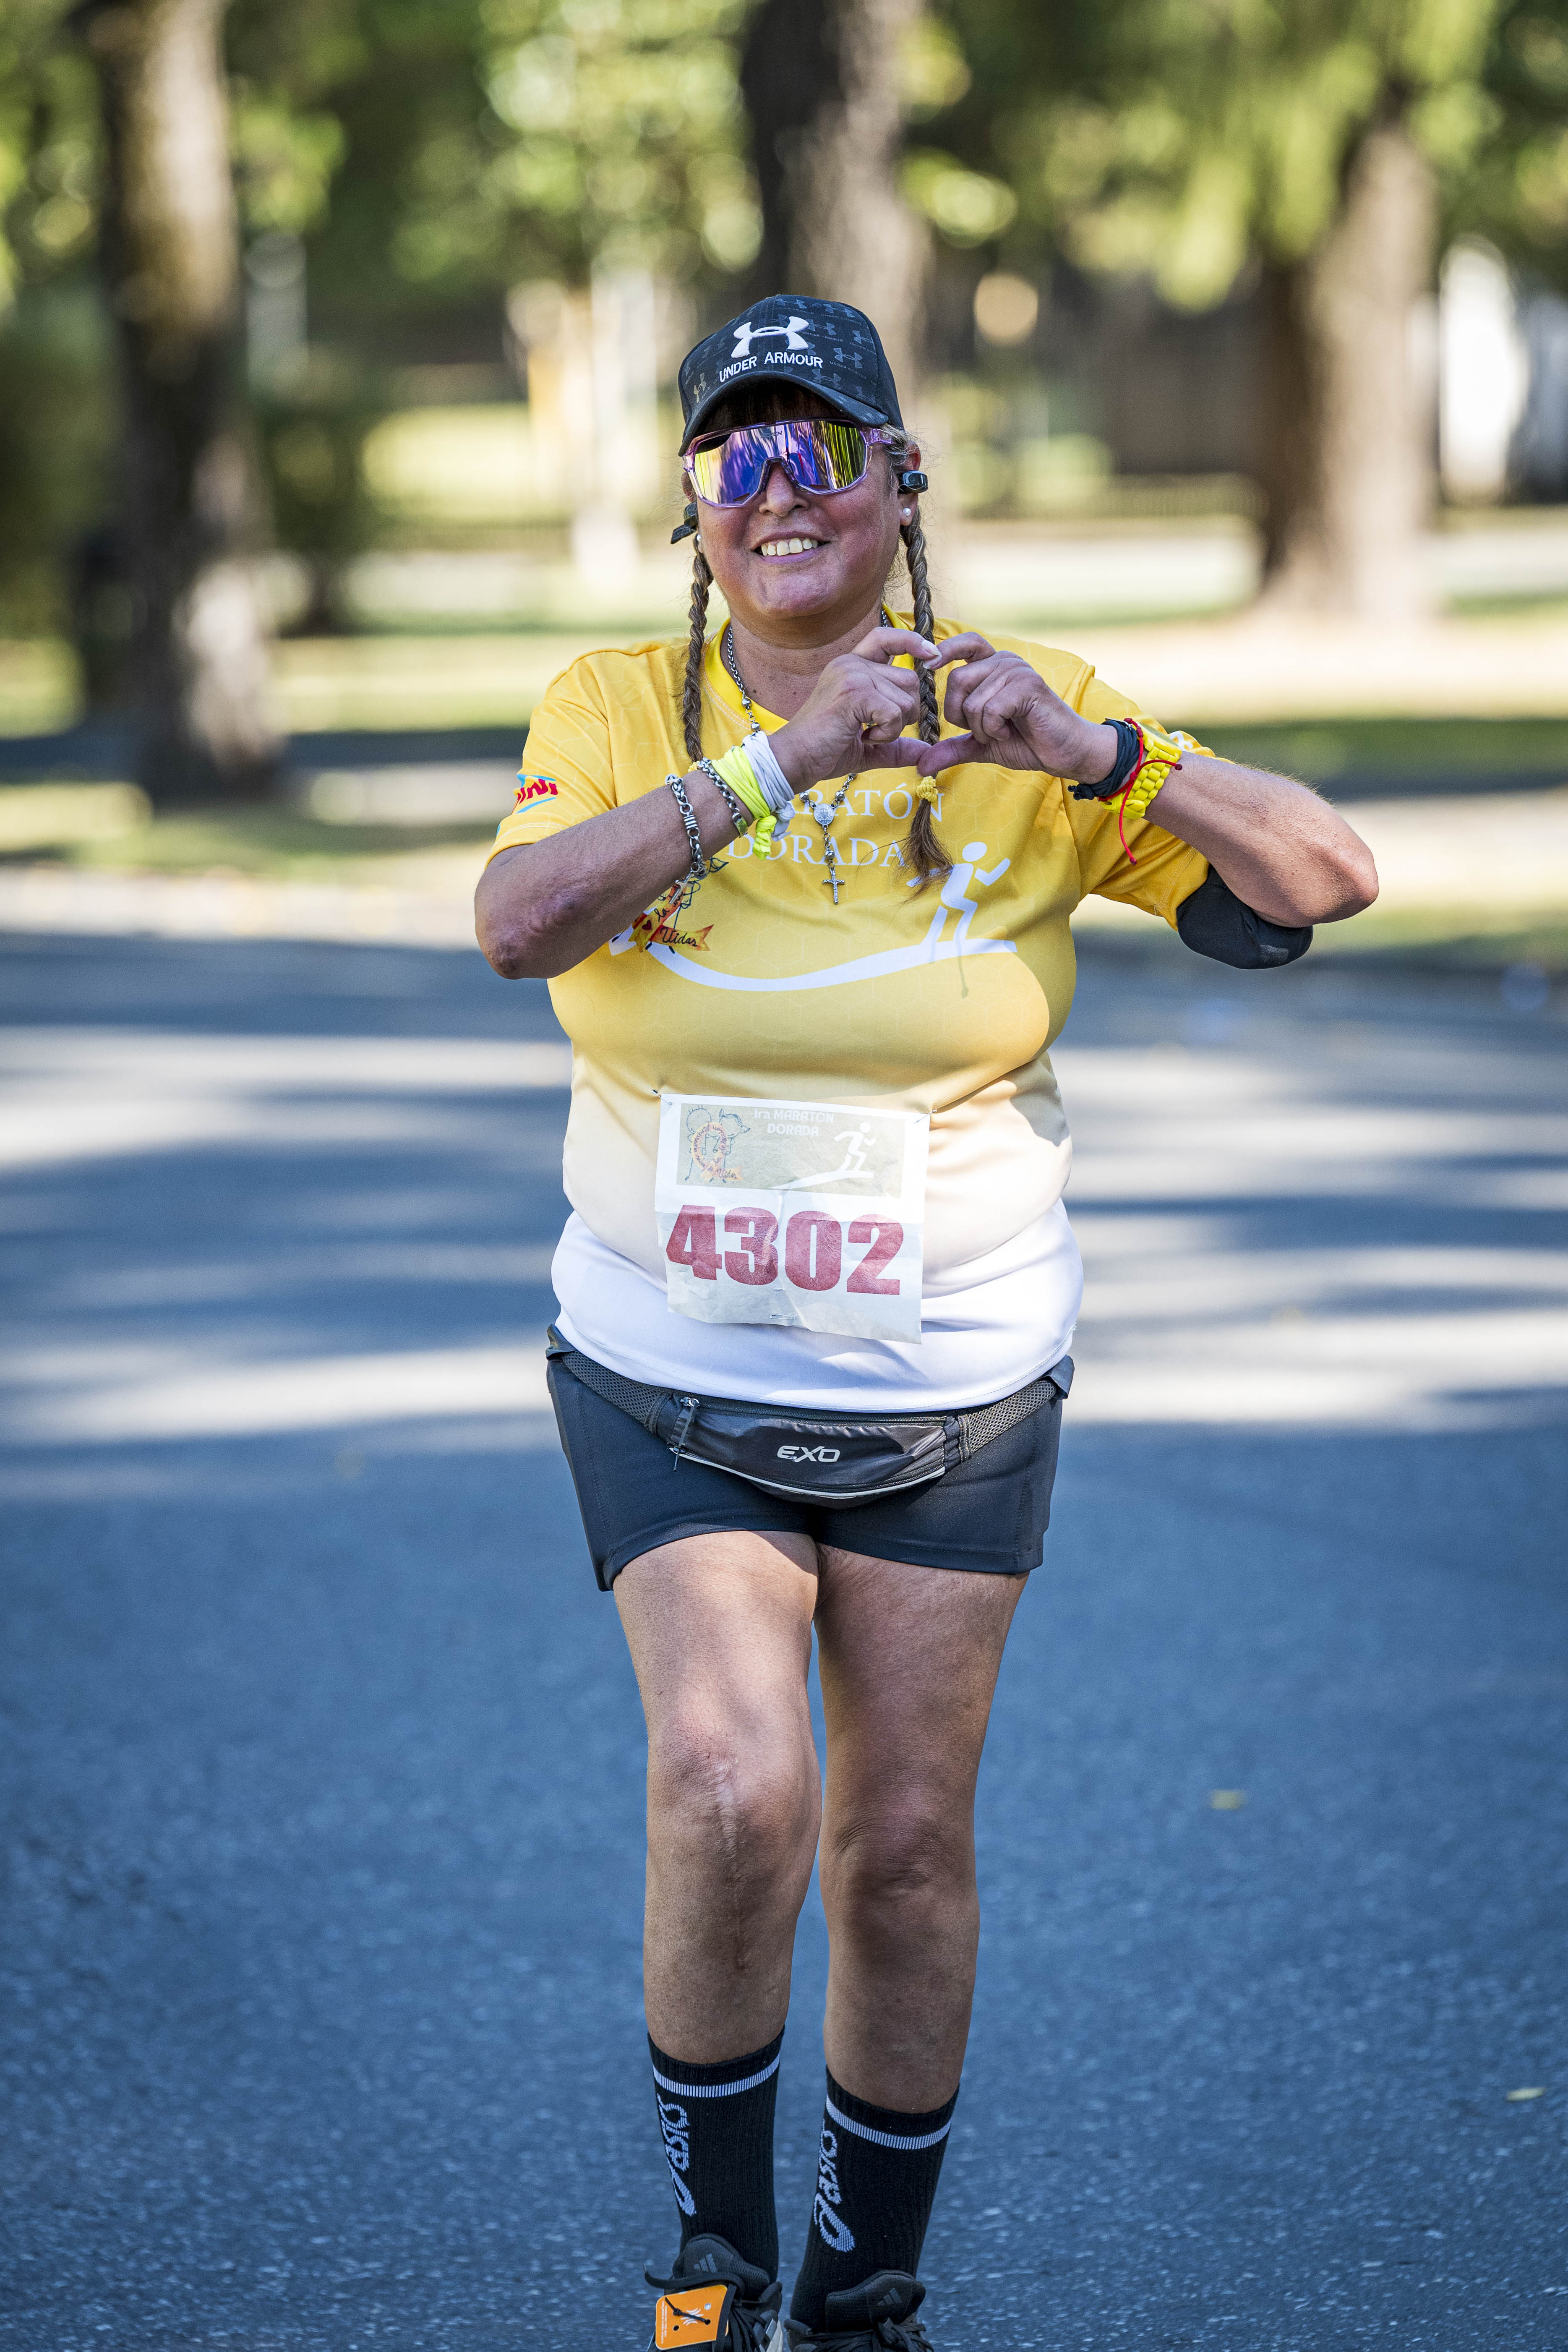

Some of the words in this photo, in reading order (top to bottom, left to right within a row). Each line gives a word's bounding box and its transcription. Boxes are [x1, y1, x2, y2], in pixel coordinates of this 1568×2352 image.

[719, 355, 757, 383] UNDER
[764, 351, 823, 368] ARMOUR
[789, 782, 945, 822] RATÓN
[767, 1123, 819, 1137] DORADA
[666, 1205, 904, 1295] 4302
[777, 1445, 840, 1463] EXO
